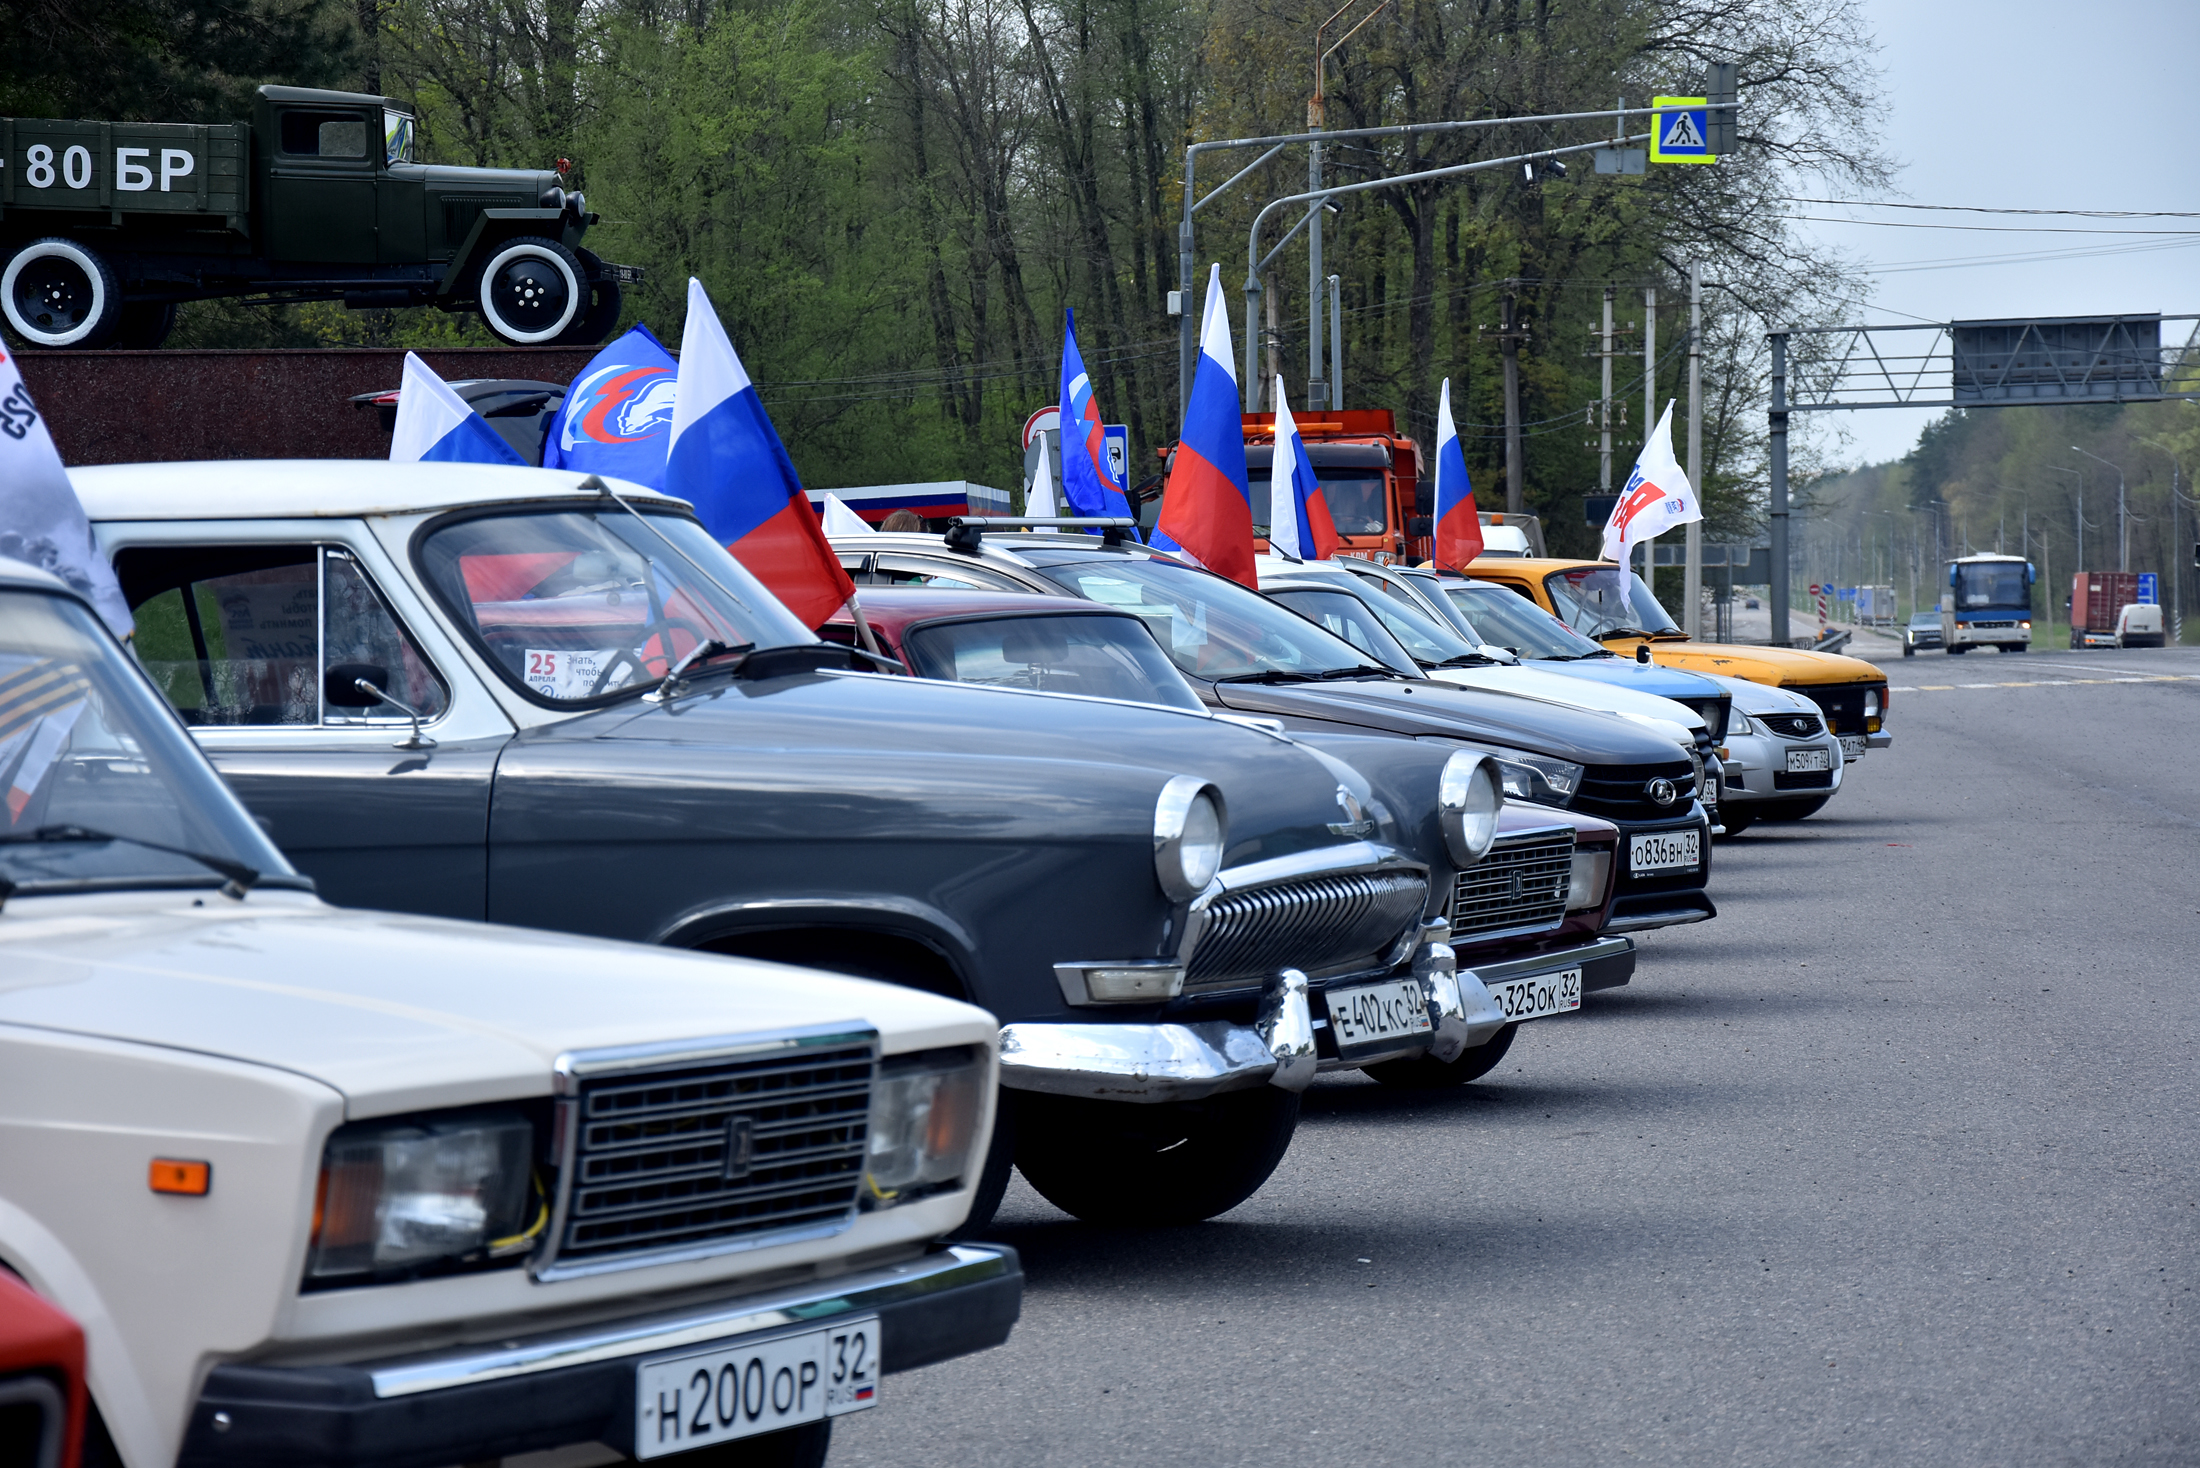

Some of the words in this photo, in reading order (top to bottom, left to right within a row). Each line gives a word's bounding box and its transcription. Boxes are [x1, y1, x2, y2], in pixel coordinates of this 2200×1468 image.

[26, 144, 92, 189] 80
[116, 147, 195, 191] БР
[530, 653, 556, 675] 25
[566, 654, 596, 666] Знать,
[1706, 780, 1714, 795] 32
[1635, 838, 1683, 866] О836ВН
[1685, 834, 1696, 853] 32
[1561, 972, 1577, 997] 32
[1337, 993, 1408, 1038] Е402КС
[1402, 984, 1422, 1015] 32
[1560, 999, 1571, 1008] RUS
[659, 1357, 818, 1443] Н200ОР
[832, 1331, 867, 1383] 32
[828, 1386, 855, 1406] RUS
